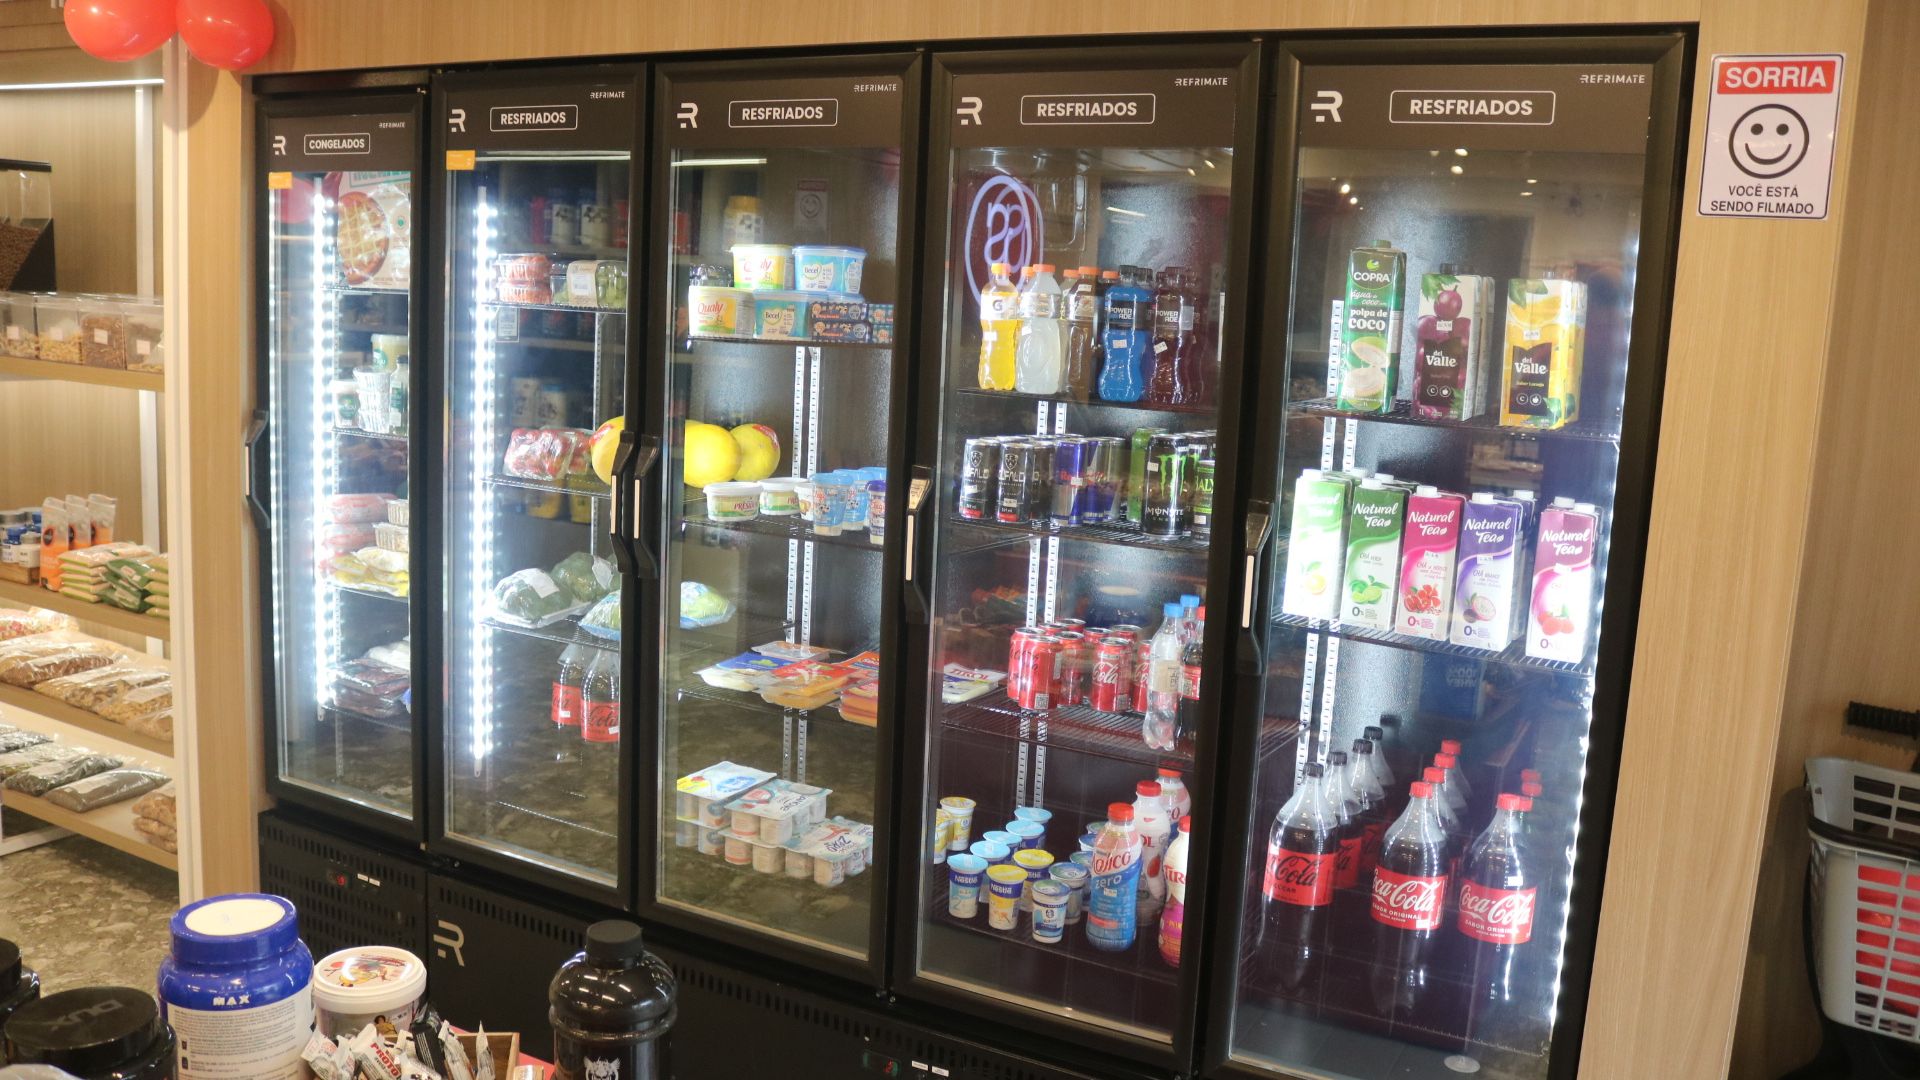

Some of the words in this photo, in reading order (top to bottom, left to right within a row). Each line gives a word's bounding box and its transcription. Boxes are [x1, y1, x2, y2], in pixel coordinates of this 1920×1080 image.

[1174, 77, 1228, 87] REFRIMATE
[1580, 74, 1646, 85] REFRIMATE
[1725, 66, 1827, 90] SORRIA
[589, 90, 625, 99] REFRIMATE
[853, 83, 898, 93] REFRIMATE
[741, 105, 824, 121] RESFRIADOS
[1036, 102, 1138, 118] RESFRIADOS
[1410, 98, 1533, 116] RESFRIADOS
[500, 111, 567, 125] RESFRIADOS
[309, 138, 365, 150] CONGELADOS
[1728, 183, 1763, 198] VOCÊ
[1766, 182, 1799, 197] ESTÁ
[1710, 199, 1753, 213] SENDO
[1757, 201, 1814, 216] FILMADO
[1353, 271, 1390, 283] COPRA
[992, 300, 1003, 311] G
[1350, 308, 1376, 318] polpa
[1376, 309, 1388, 318] de
[1425, 355, 1458, 367] Valle
[1514, 362, 1547, 375] Valle
[1353, 502, 1399, 516] Natural
[1364, 515, 1385, 528] Tea
[1408, 510, 1455, 524] Natural
[1419, 524, 1441, 537] Tea
[1464, 517, 1512, 532] Natural
[1475, 531, 1498, 545] Tea
[1540, 528, 1591, 543] Natural
[1552, 543, 1575, 556] Tea
[954, 874, 978, 884] Nestlé
[1095, 874, 1122, 889] zero
[990, 883, 1012, 895] Nestlé
[1459, 884, 1532, 925] Coca-Cola
[1389, 909, 1421, 921] ORIGINAL
[212, 994, 250, 1007] MAX
